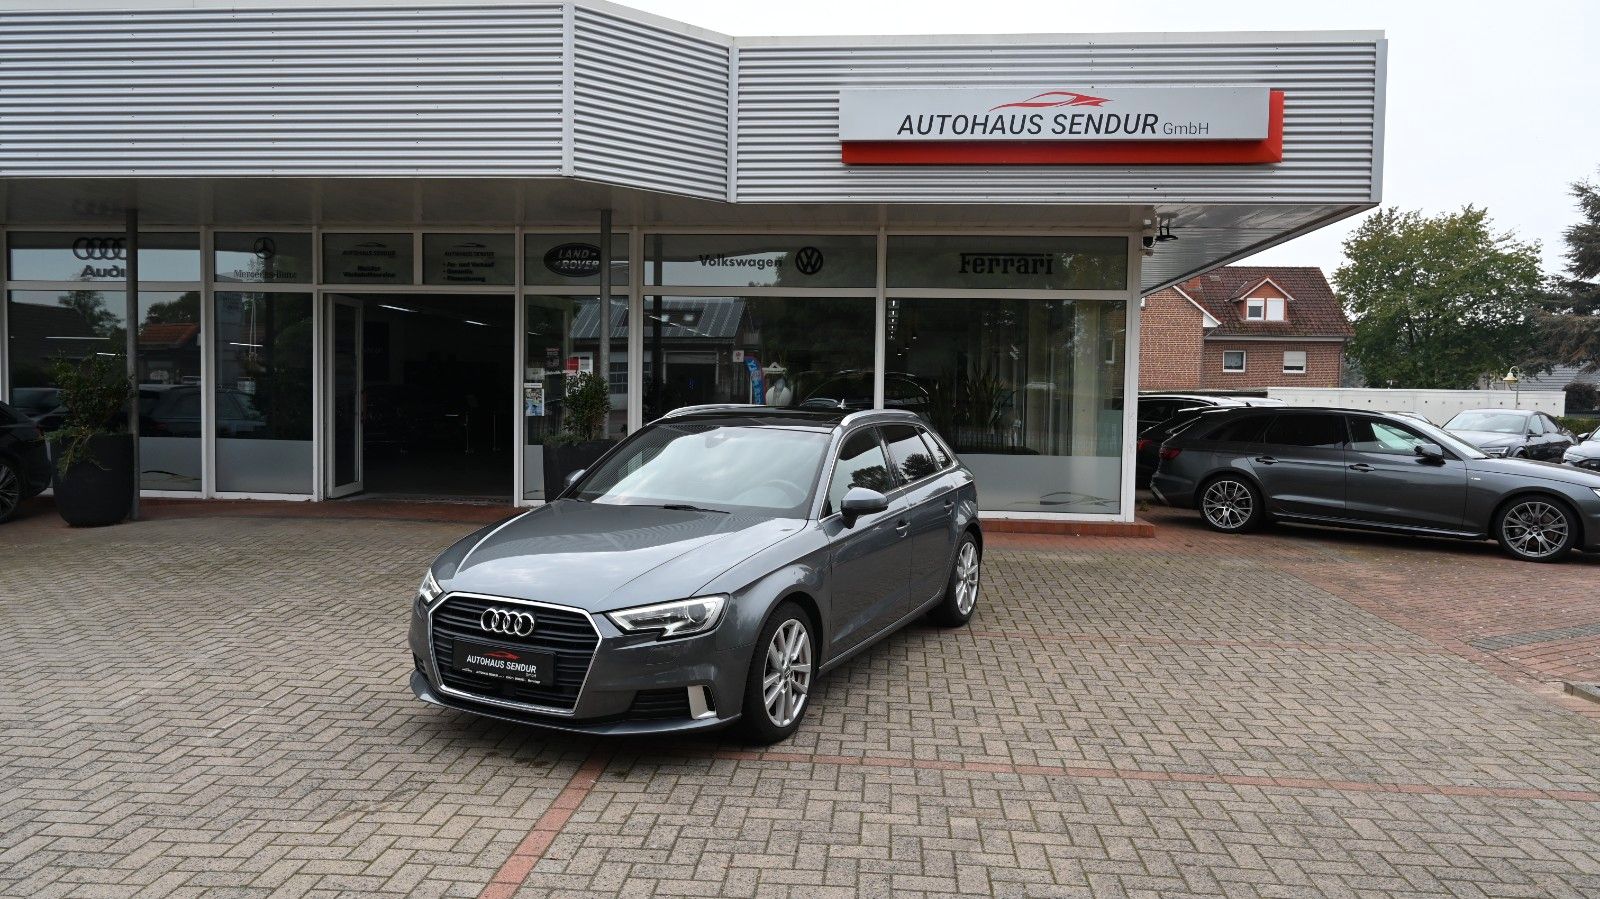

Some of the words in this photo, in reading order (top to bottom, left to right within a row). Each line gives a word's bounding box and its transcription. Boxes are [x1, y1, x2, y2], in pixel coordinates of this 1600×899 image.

[897, 113, 1044, 136] AUTOHAUS
[1051, 112, 1159, 136] SENDUR
[1163, 121, 1209, 136] GmbH
[560, 259, 600, 270] ROVER
[699, 254, 783, 270] Volkswagen
[959, 252, 1053, 275] Ferrari
[466, 654, 505, 669] AUTOHAUS
[505, 660, 537, 674] SENDUR
